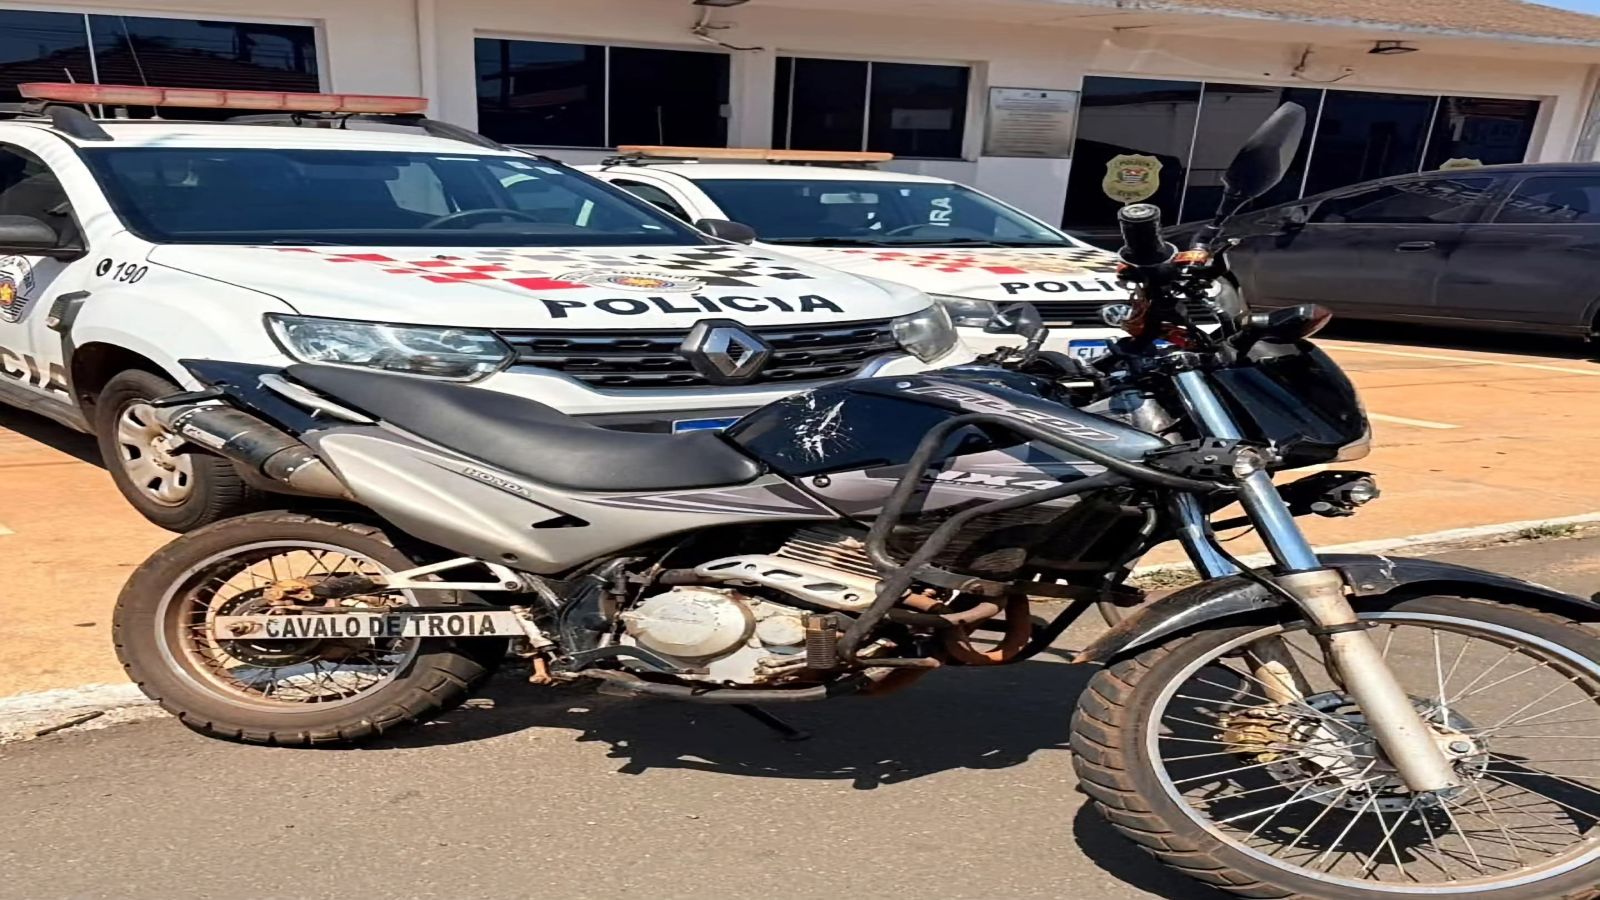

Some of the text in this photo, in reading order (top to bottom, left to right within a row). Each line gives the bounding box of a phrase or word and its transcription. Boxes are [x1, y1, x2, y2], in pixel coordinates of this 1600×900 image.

[929, 197, 952, 227] IRA
[112, 261, 148, 284] 190
[540, 293, 845, 318] POLÍCIA
[463, 467, 533, 497] HONDA
[266, 614, 496, 638] CAVALO DE TROIA
